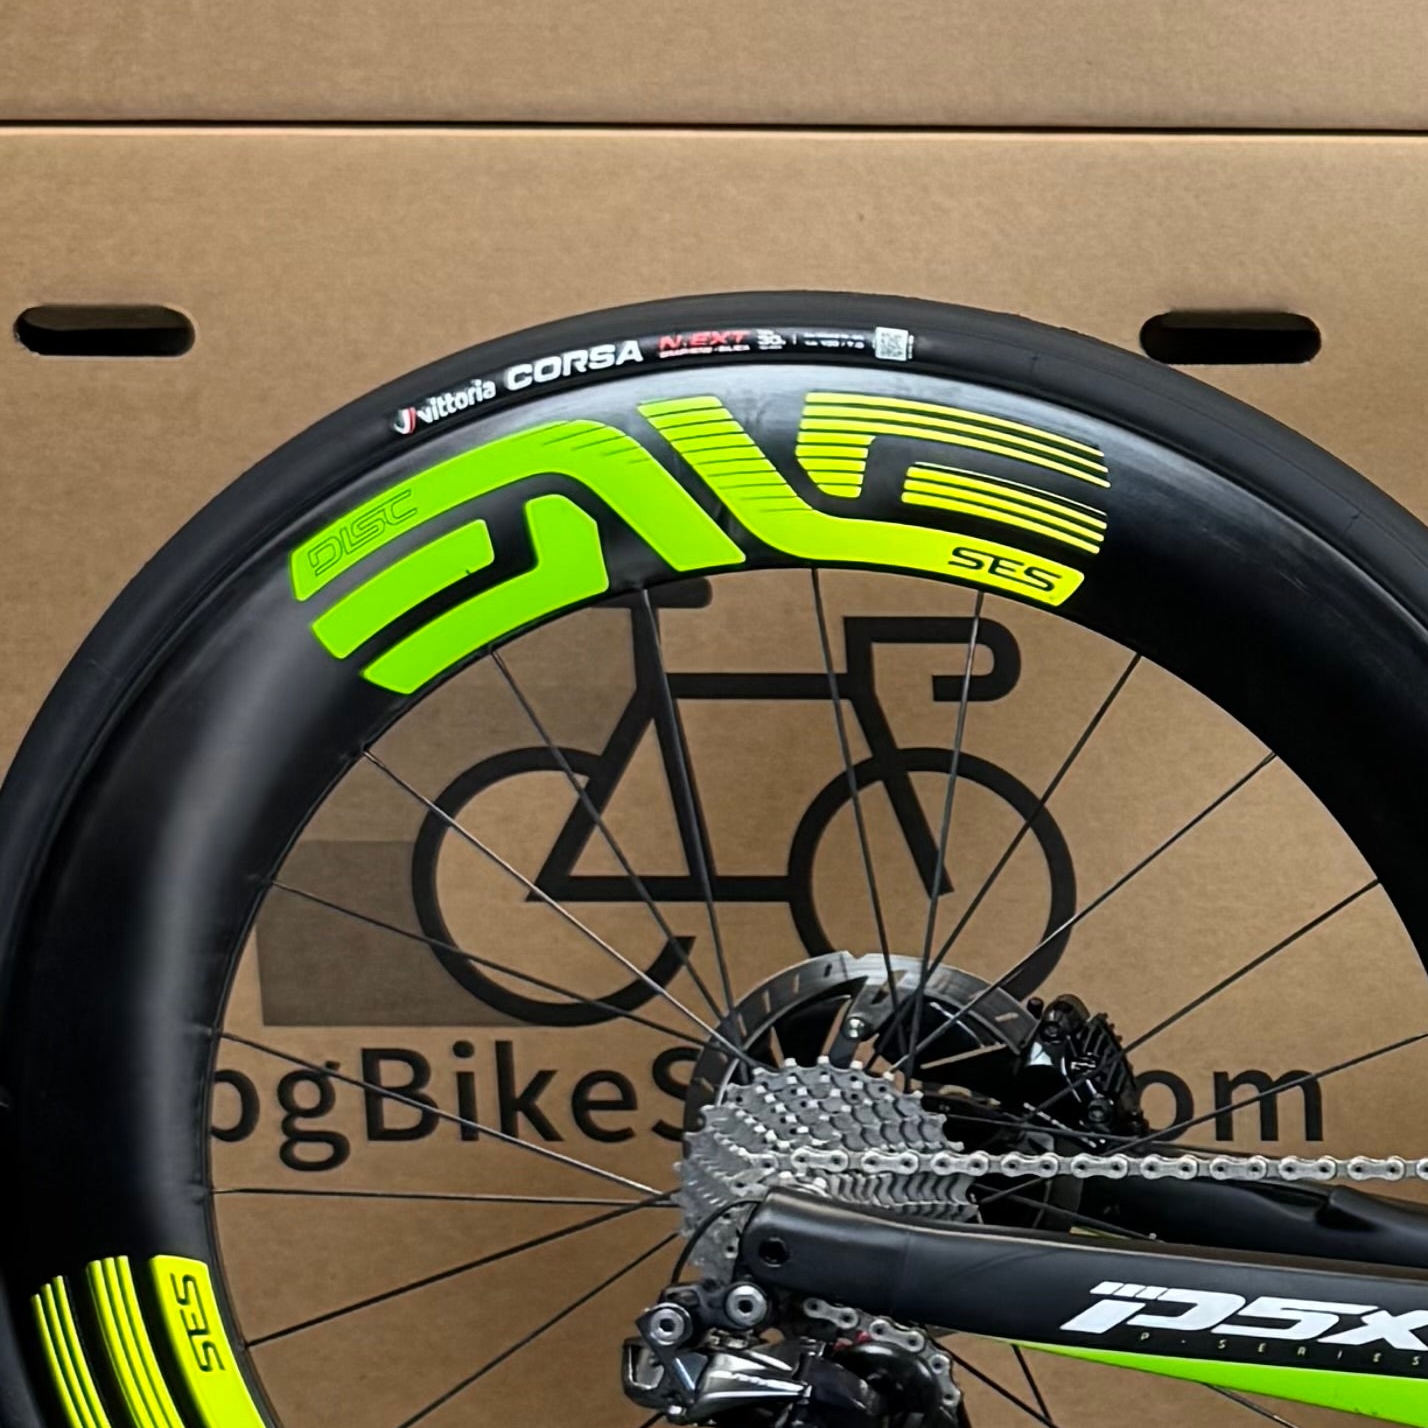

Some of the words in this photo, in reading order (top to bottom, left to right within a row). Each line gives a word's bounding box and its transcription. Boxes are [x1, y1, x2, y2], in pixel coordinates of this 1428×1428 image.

[416, 379, 497, 426] vittoria
[506, 340, 644, 392] CORSA
[305, 488, 419, 578] DISC
[948, 546, 1059, 592] SES
[169, 1272, 225, 1374] SES
